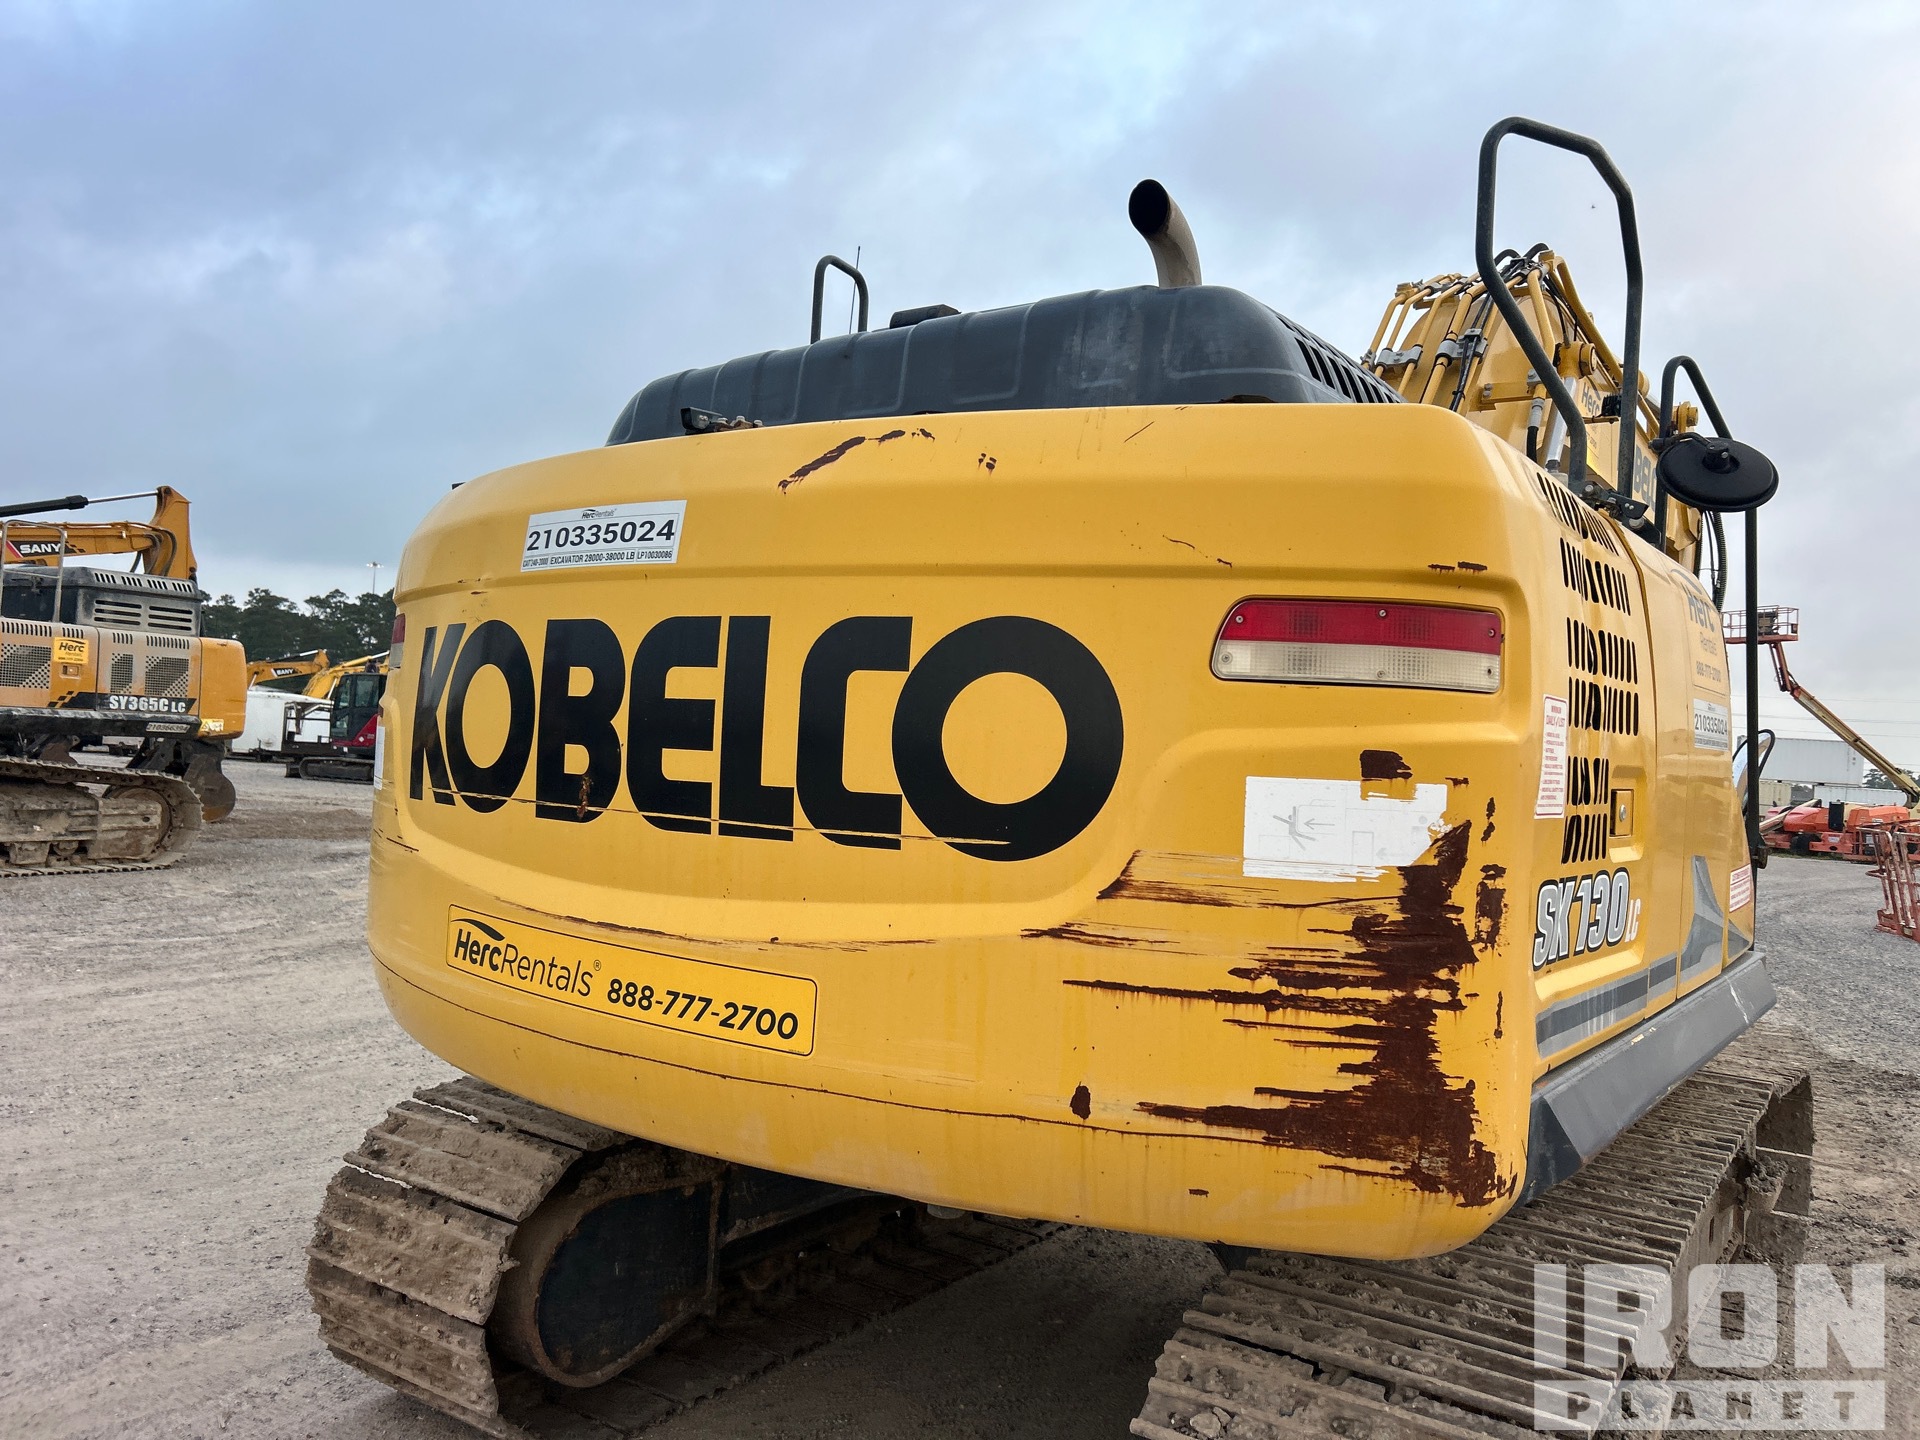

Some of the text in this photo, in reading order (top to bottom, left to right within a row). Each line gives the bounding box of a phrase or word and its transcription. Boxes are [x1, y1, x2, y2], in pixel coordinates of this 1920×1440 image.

[527, 520, 675, 551] 210335024
[20, 543, 61, 554] SANY
[550, 554, 583, 565] EXCAVATOR
[626, 551, 635, 560] LB
[58, 641, 85, 653] Herc
[109, 695, 186, 713] SY365C LC
[409, 615, 1124, 862] KOBELCO
[1533, 867, 1630, 972] SK130
[607, 978, 799, 1040] 888-777-2700
